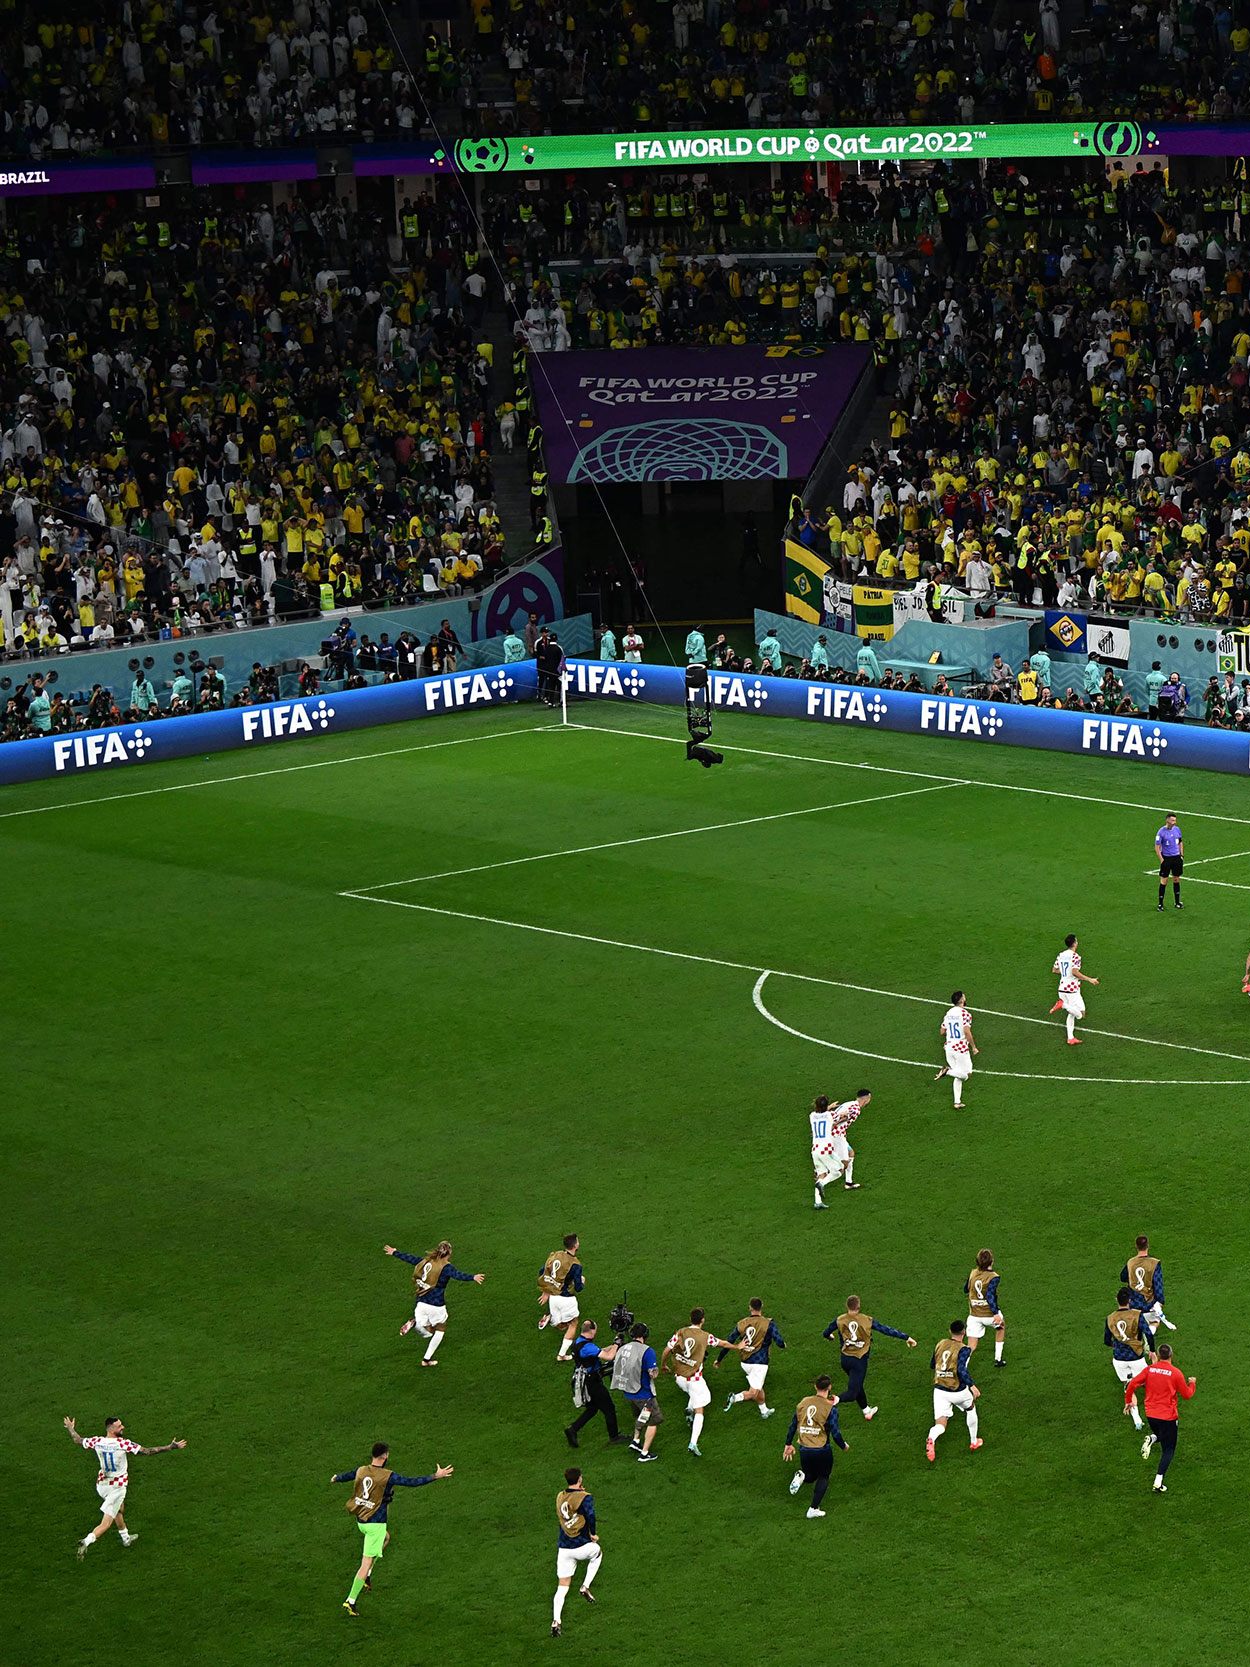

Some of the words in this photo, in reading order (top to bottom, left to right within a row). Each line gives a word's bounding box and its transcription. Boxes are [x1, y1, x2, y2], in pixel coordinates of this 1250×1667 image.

[615, 140, 667, 160] FIFA
[667, 137, 753, 158] WORLD
[756, 136, 801, 156] CUP
[0, 170, 50, 185] BRAZIL
[578, 376, 643, 389] FIFA
[646, 375, 756, 388] WORLD
[759, 371, 819, 384] CUP
[424, 674, 491, 711] FIFA
[807, 686, 867, 722] FIFA
[241, 704, 313, 741] FIFA
[920, 699, 982, 736] FIFA
[1082, 718, 1146, 757] FIFA
[54, 732, 128, 771] FIFA
[1060, 961, 1069, 978] 17
[948, 1021, 961, 1039] 16
[813, 1120, 827, 1139] 10
[102, 1451, 117, 1472] 11
